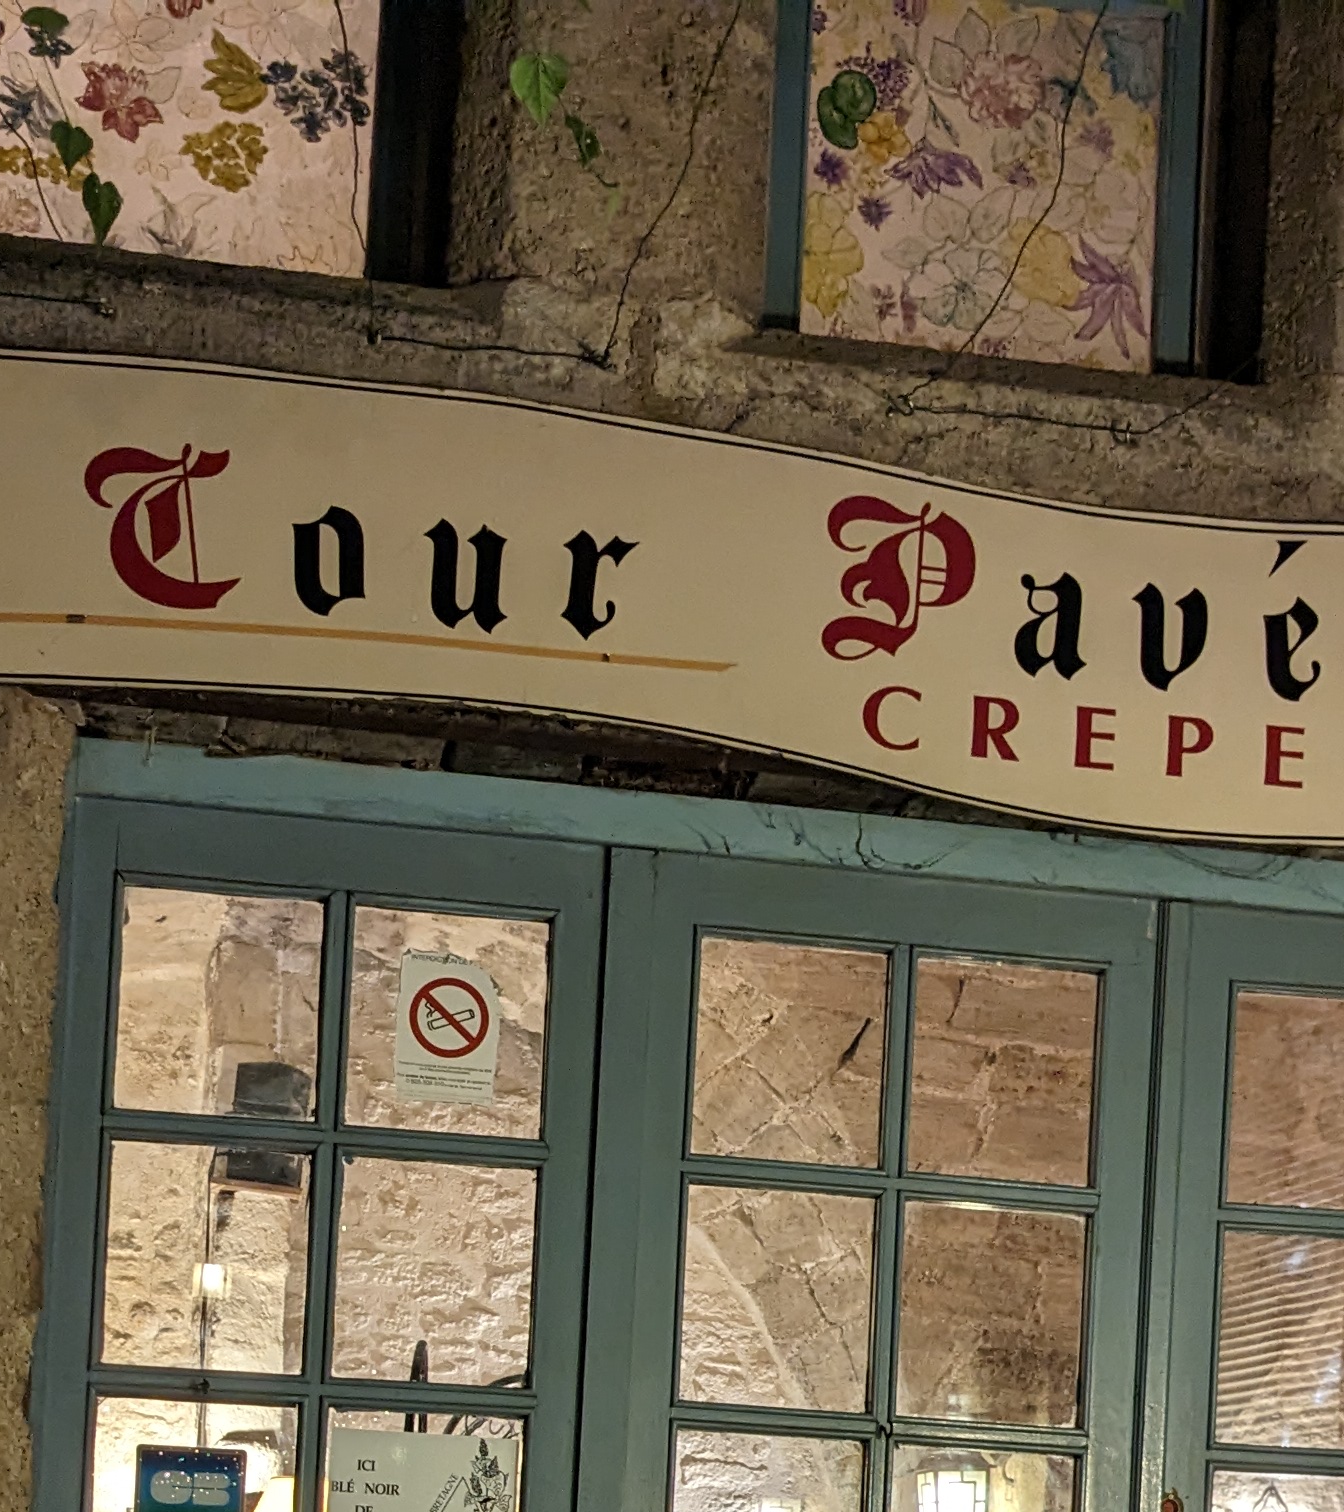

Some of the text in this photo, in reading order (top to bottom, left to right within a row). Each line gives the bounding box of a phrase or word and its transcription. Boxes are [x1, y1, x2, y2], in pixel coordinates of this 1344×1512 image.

[84, 443, 640, 641] Tour
[357, 1459, 376, 1472] ICI
[150, 1470, 231, 1506] CB
[331, 1479, 400, 1496] BLÉ NOIR
